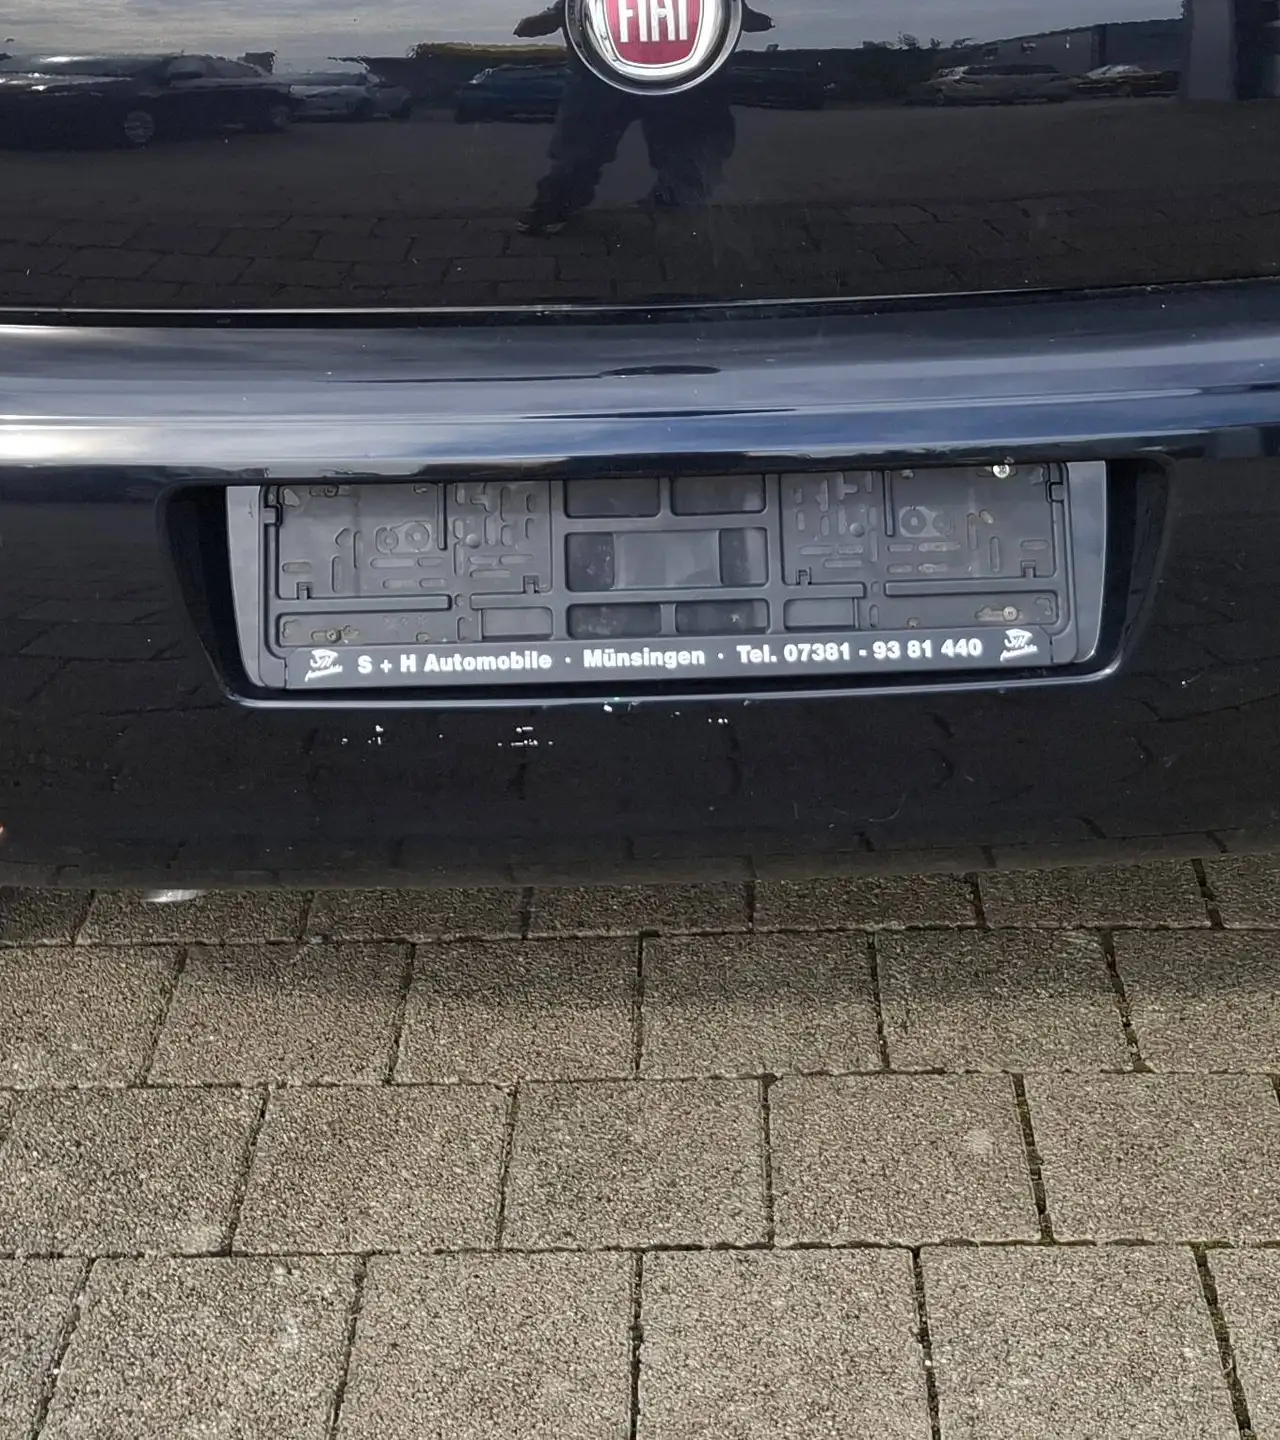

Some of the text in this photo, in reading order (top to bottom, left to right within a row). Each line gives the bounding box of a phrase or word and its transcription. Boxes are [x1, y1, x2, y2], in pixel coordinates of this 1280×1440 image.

[357, 654, 373, 674] S
[400, 653, 417, 672] H
[423, 650, 552, 672] Automobile
[583, 647, 706, 669] Münsingen
[736, 644, 777, 663] Tel.
[783, 642, 851, 663] 07381
[872, 641, 901, 659] 93
[907, 640, 933, 658] 81
[941, 638, 983, 658] 440
